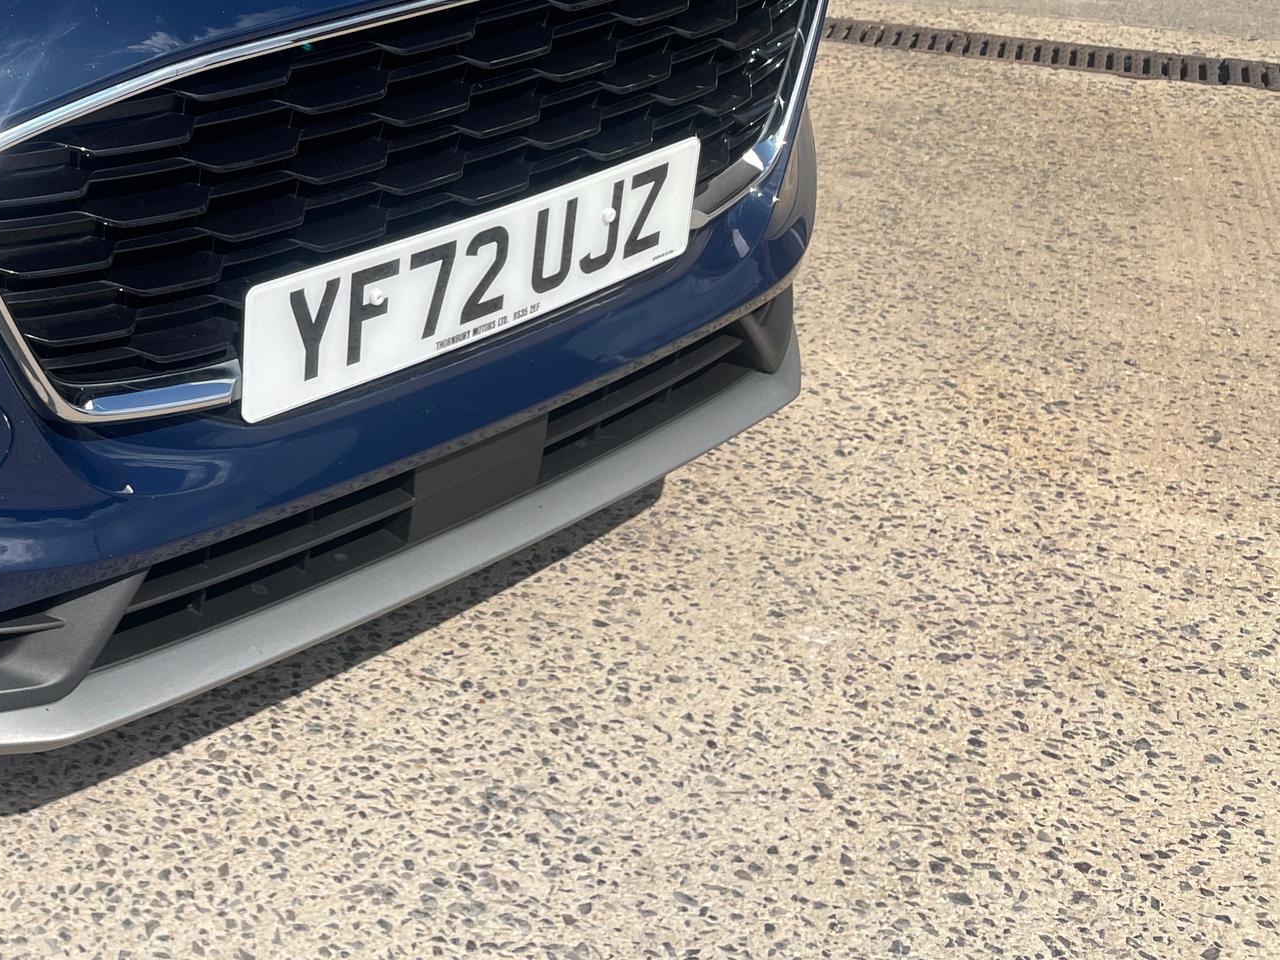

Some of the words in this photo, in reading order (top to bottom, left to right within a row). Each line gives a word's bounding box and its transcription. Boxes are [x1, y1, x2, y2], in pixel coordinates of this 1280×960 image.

[290, 225, 510, 381] YF72
[531, 163, 669, 294] UJZ
[436, 331, 470, 350] THORNBURY
[472, 321, 496, 336] MOTORS
